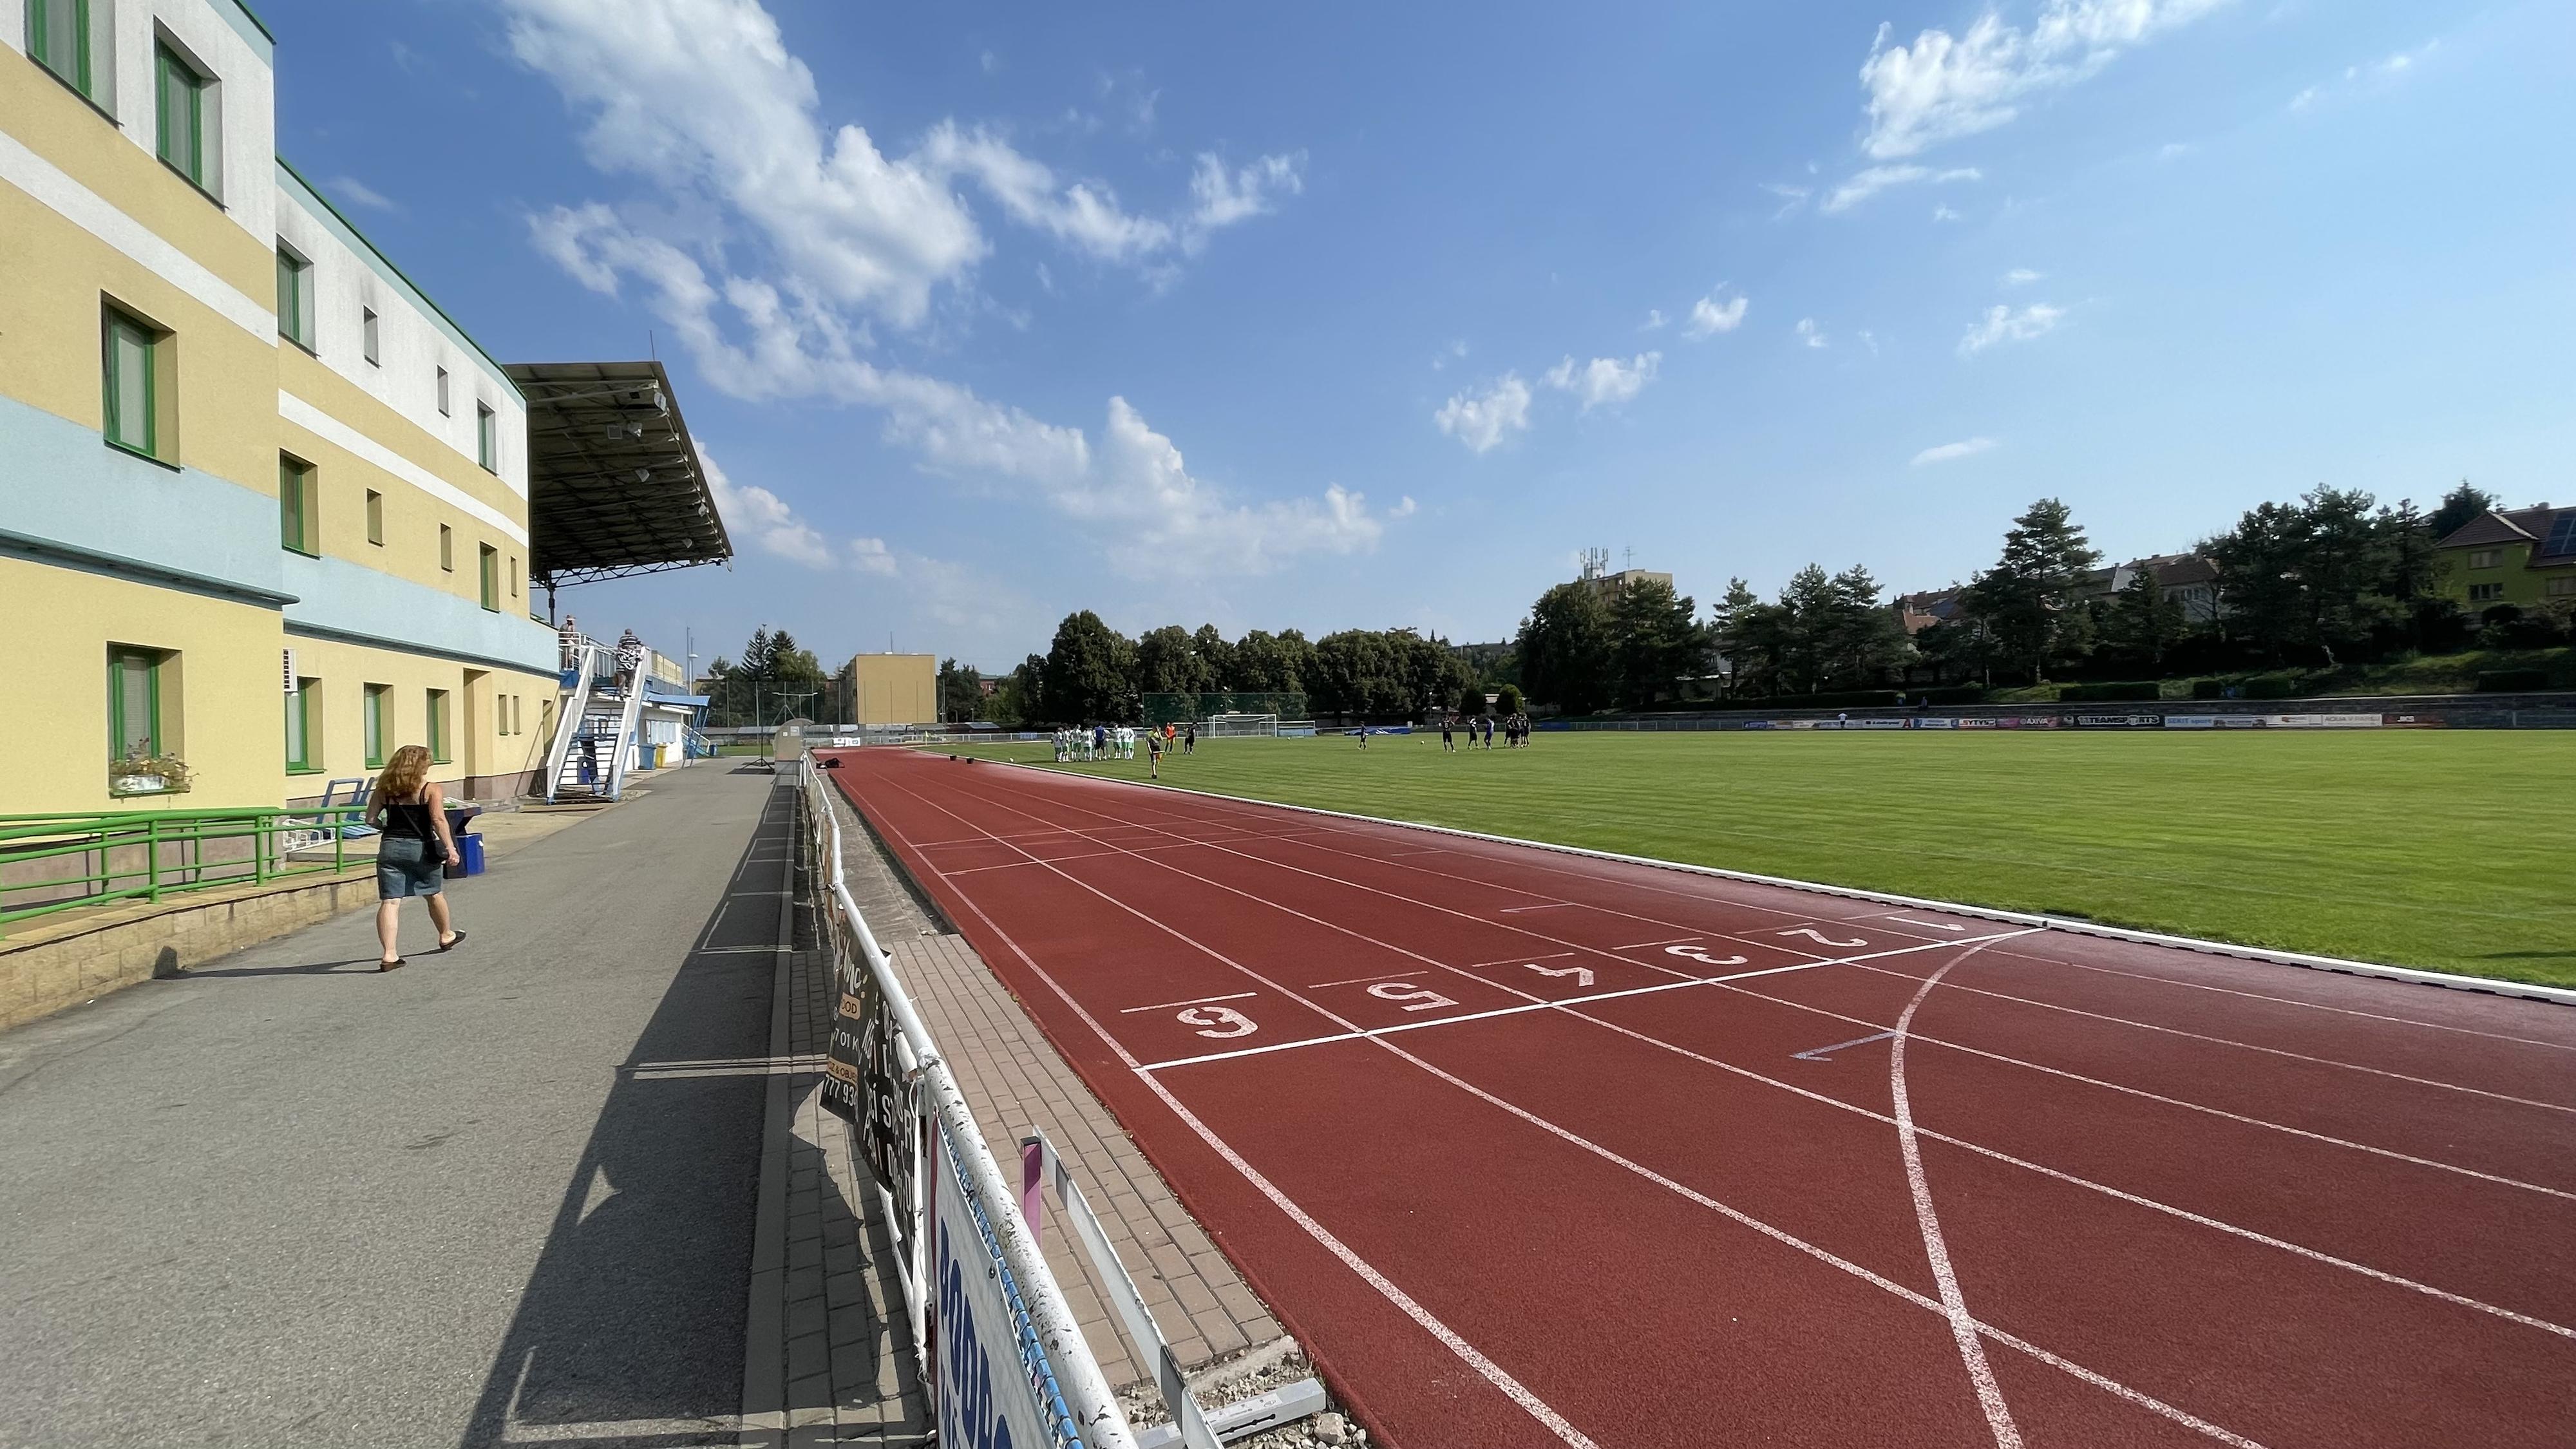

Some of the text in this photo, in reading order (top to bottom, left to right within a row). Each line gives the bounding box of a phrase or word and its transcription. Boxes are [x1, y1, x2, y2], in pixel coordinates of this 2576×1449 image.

[1776, 928, 1868, 947] 2
[1665, 945, 1748, 965] 3
[1523, 963, 1594, 987] 4
[1366, 982, 1459, 1012] 5
[1176, 1006, 1258, 1038] 6
[824, 1073, 840, 1099] 777
